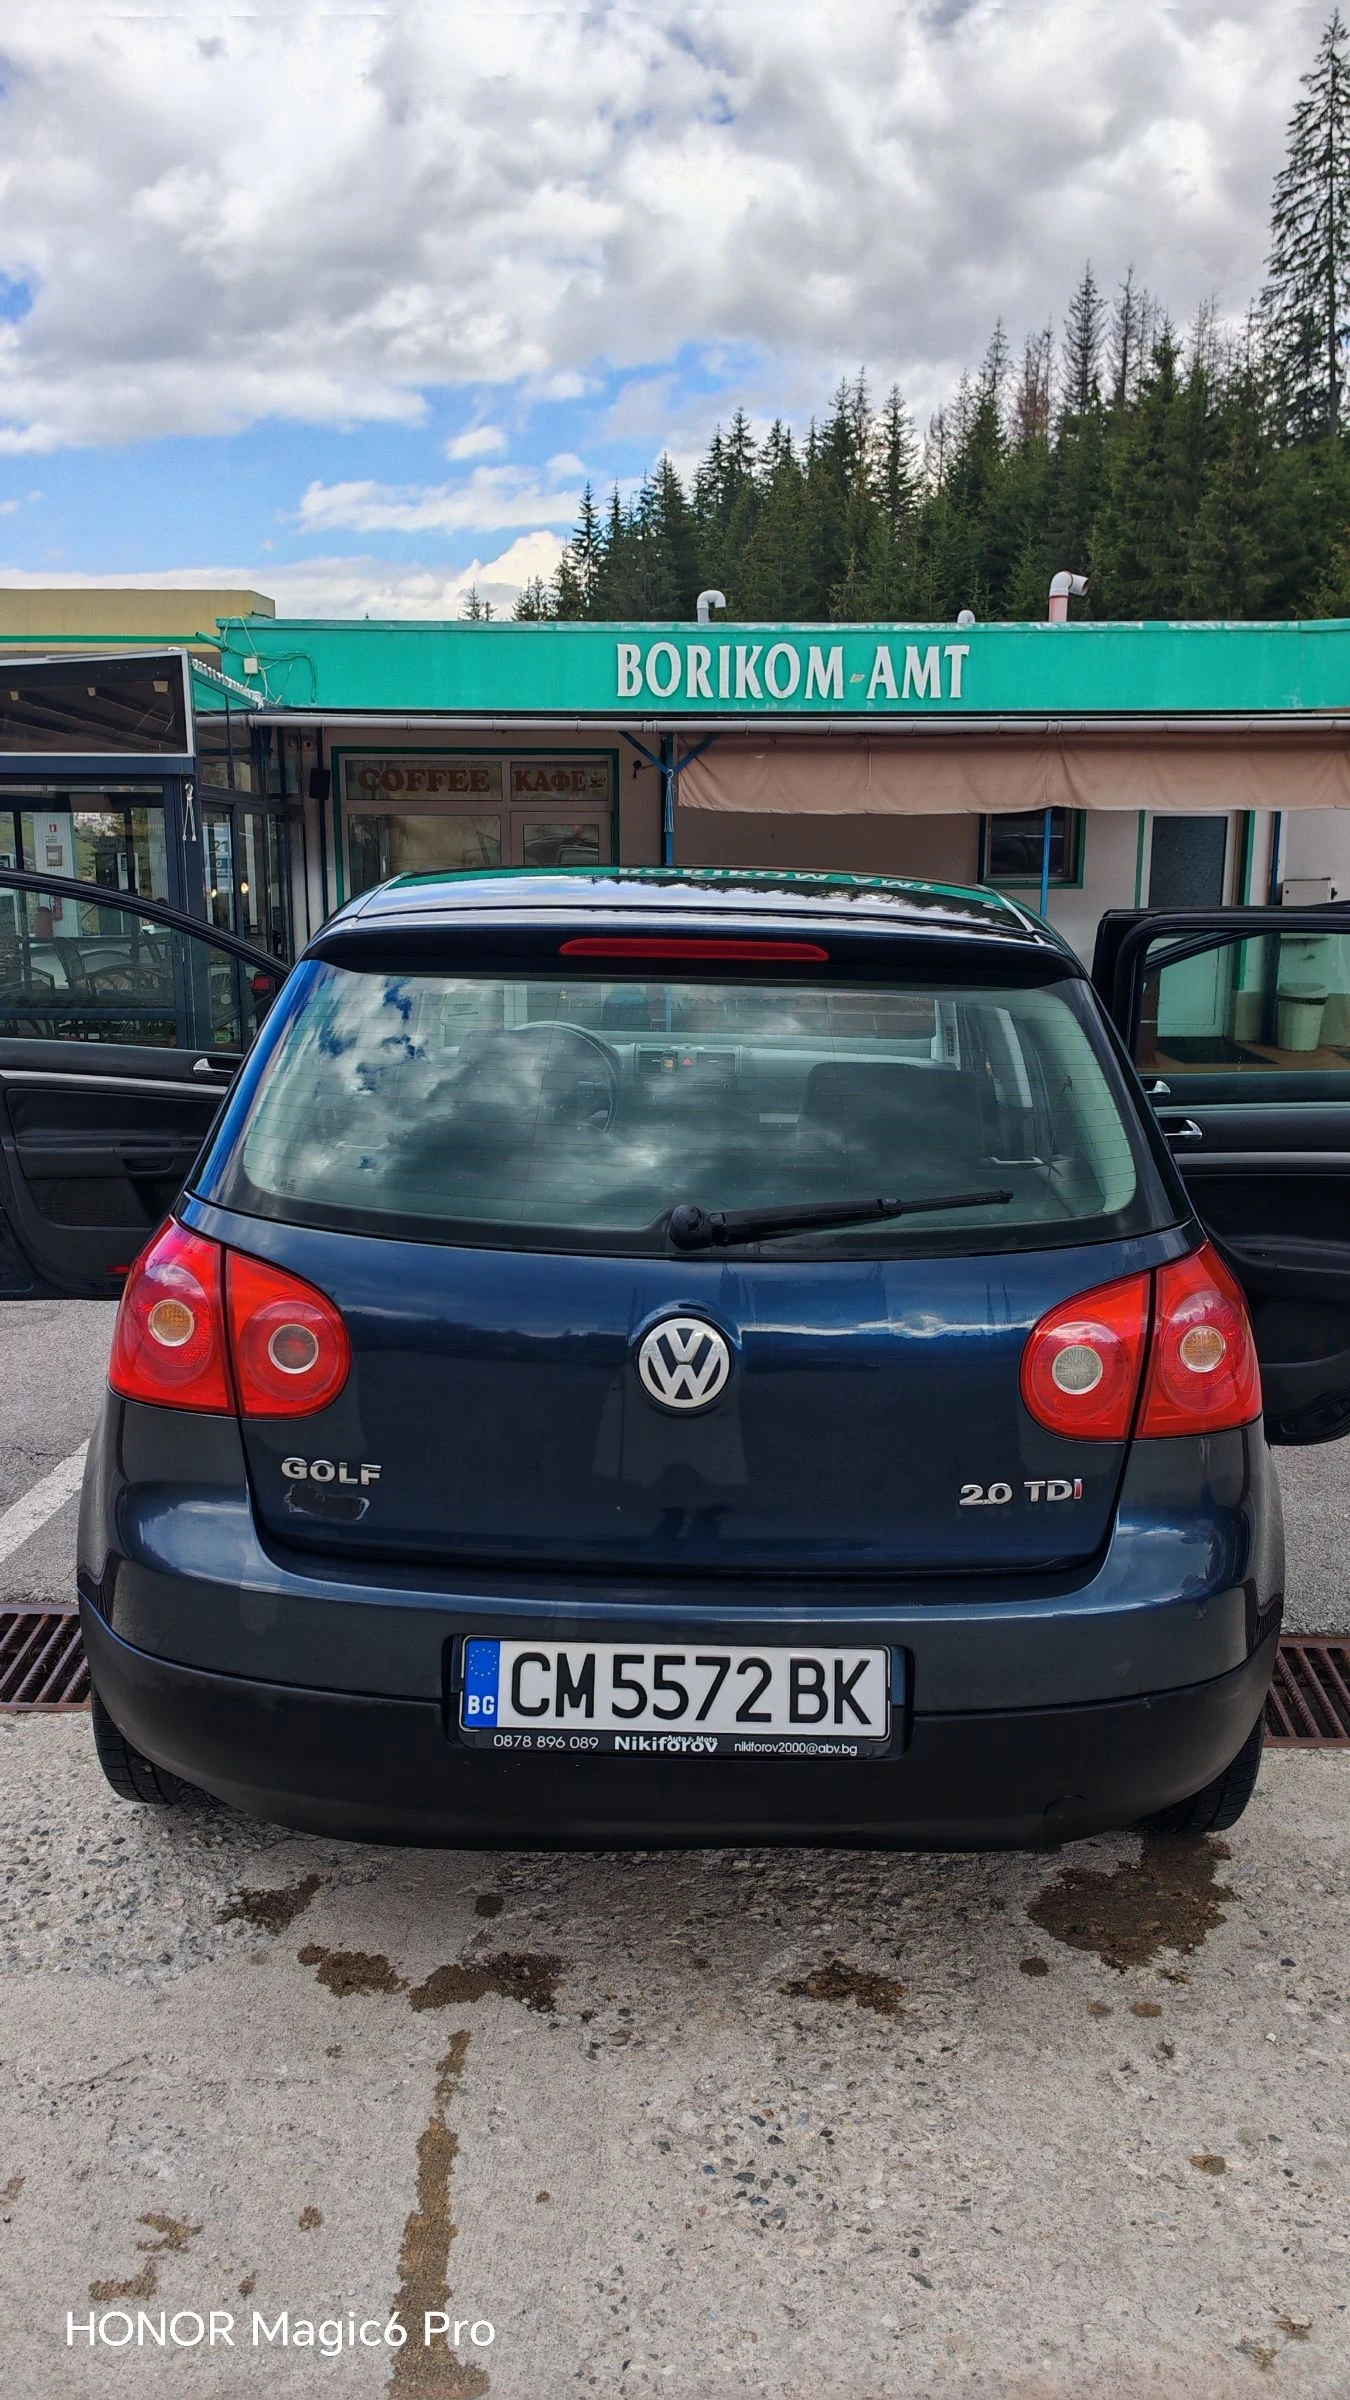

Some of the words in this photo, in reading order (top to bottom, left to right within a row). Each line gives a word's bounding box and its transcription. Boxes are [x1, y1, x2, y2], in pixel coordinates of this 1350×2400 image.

[616, 642, 844, 699] BORIKOM
[866, 644, 970, 699] AMT
[358, 768, 491, 793] COFFEE
[514, 768, 588, 792] КАФЕ
[638, 1318, 730, 1409] VW
[281, 1457, 382, 1486] GOLF
[1023, 1478, 1083, 1503] TDI
[467, 1695, 495, 1715] BG
[493, 1734, 532, 1748] 0878
[536, 1735, 566, 1749] 896
[569, 1736, 599, 1750] 089
[614, 1735, 719, 1753] Nikiforov
[734, 1741, 858, 1756] nikiforov2000@abv.bg
